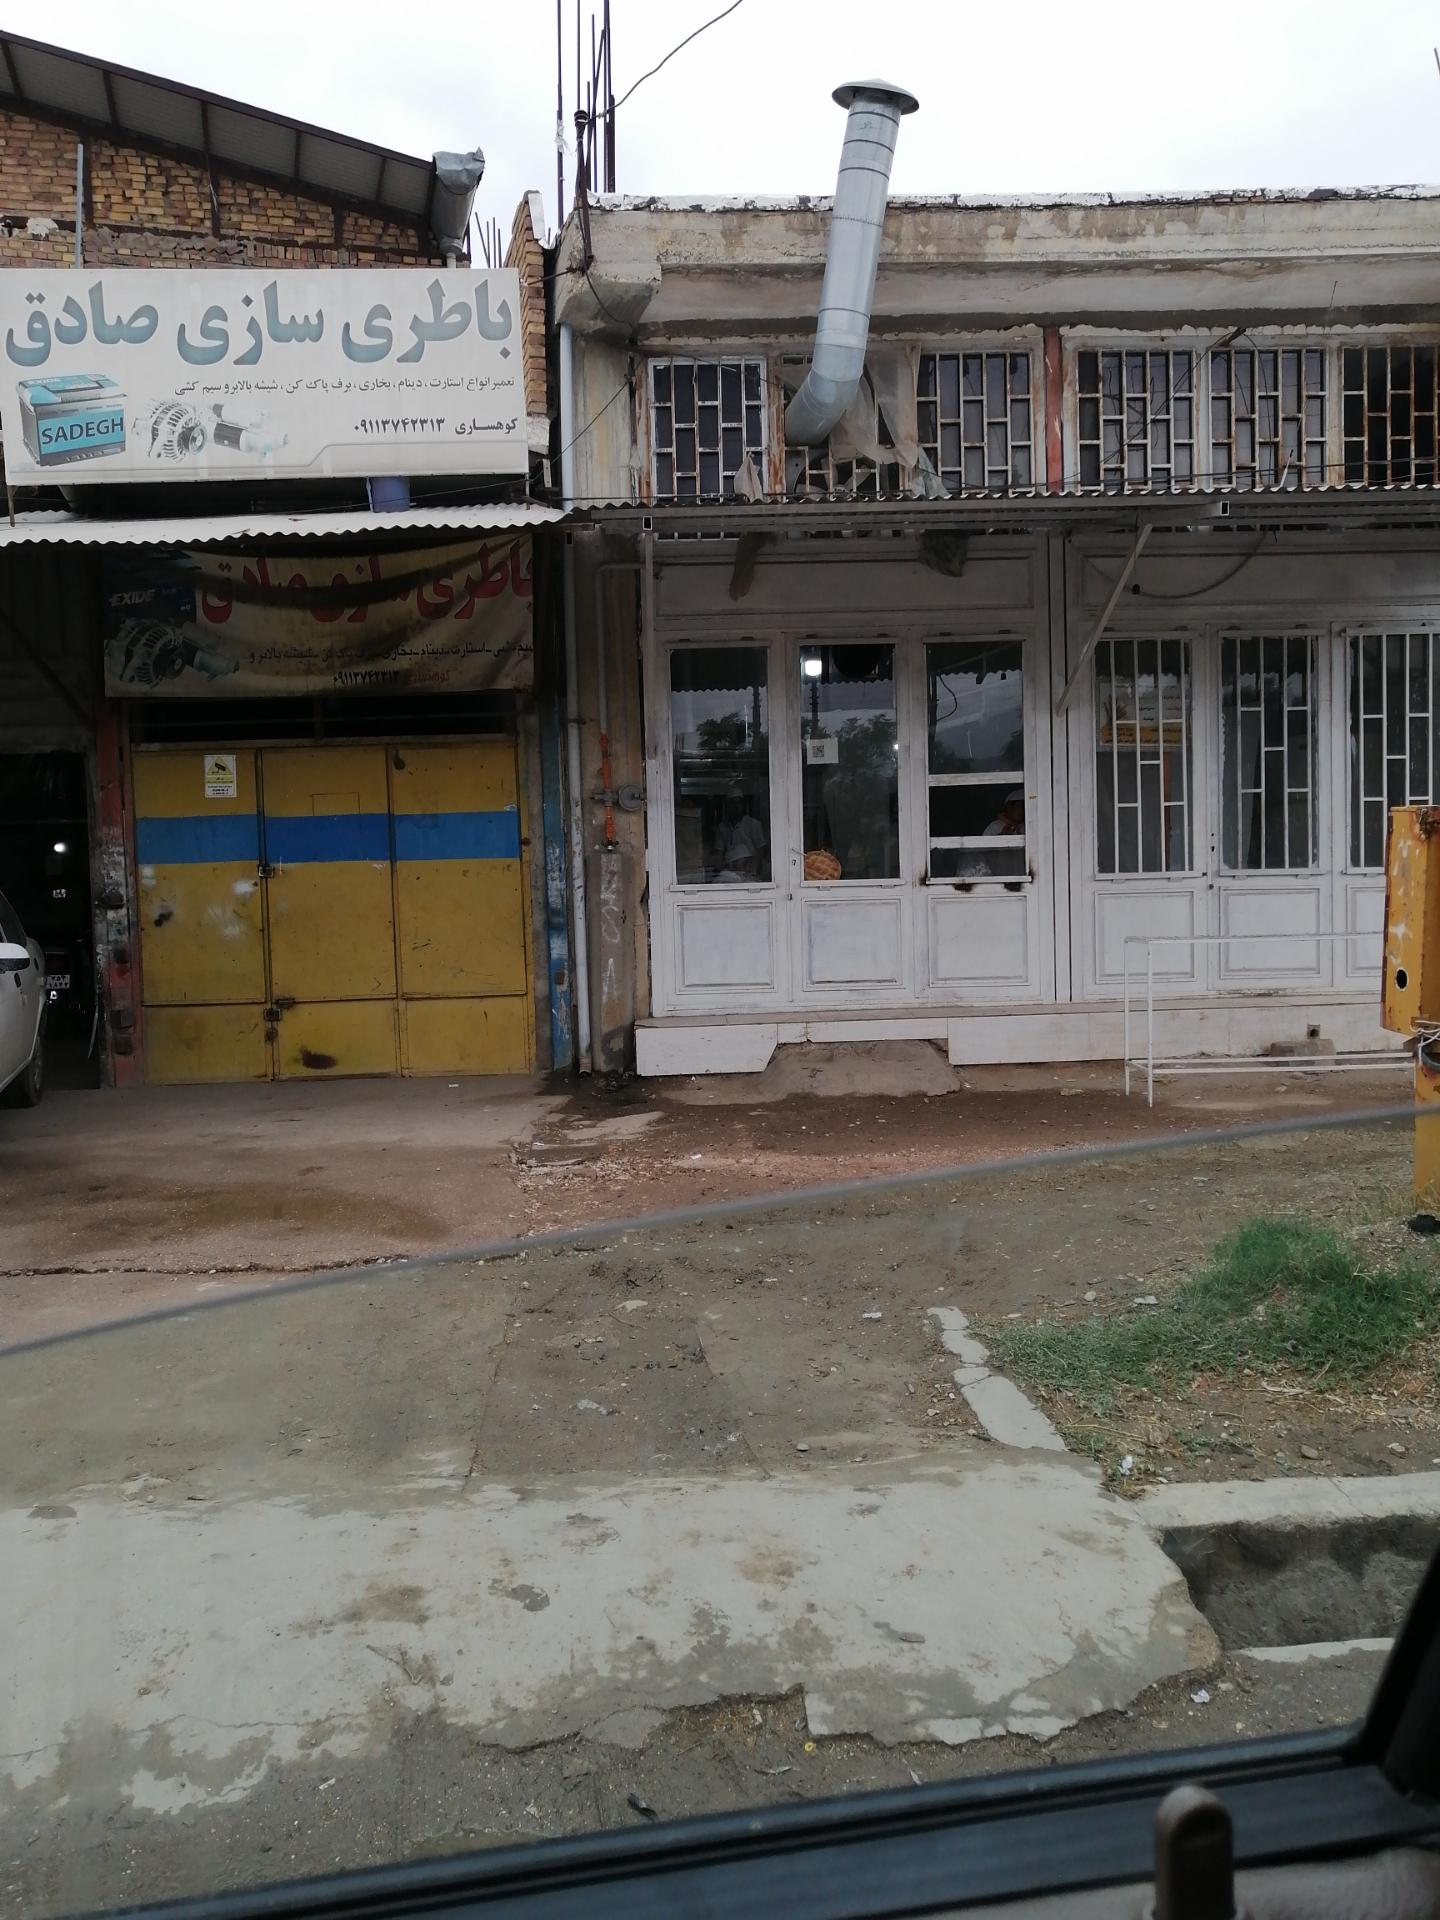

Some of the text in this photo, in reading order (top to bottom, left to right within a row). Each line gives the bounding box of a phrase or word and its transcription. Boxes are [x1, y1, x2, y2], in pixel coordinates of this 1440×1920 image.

[6, 278, 512, 367] باطری سازی صادق
[174, 380, 200, 396] کشی
[202, 384, 222, 395] سیم
[254, 379, 279, 393] شیشه
[305, 379, 328, 393] پاک
[331, 379, 352, 393] برف
[41, 417, 124, 445] SADEGH
[353, 417, 518, 435] کوهساری ۰۹۱۱۳۷۴۲۳۱۳
